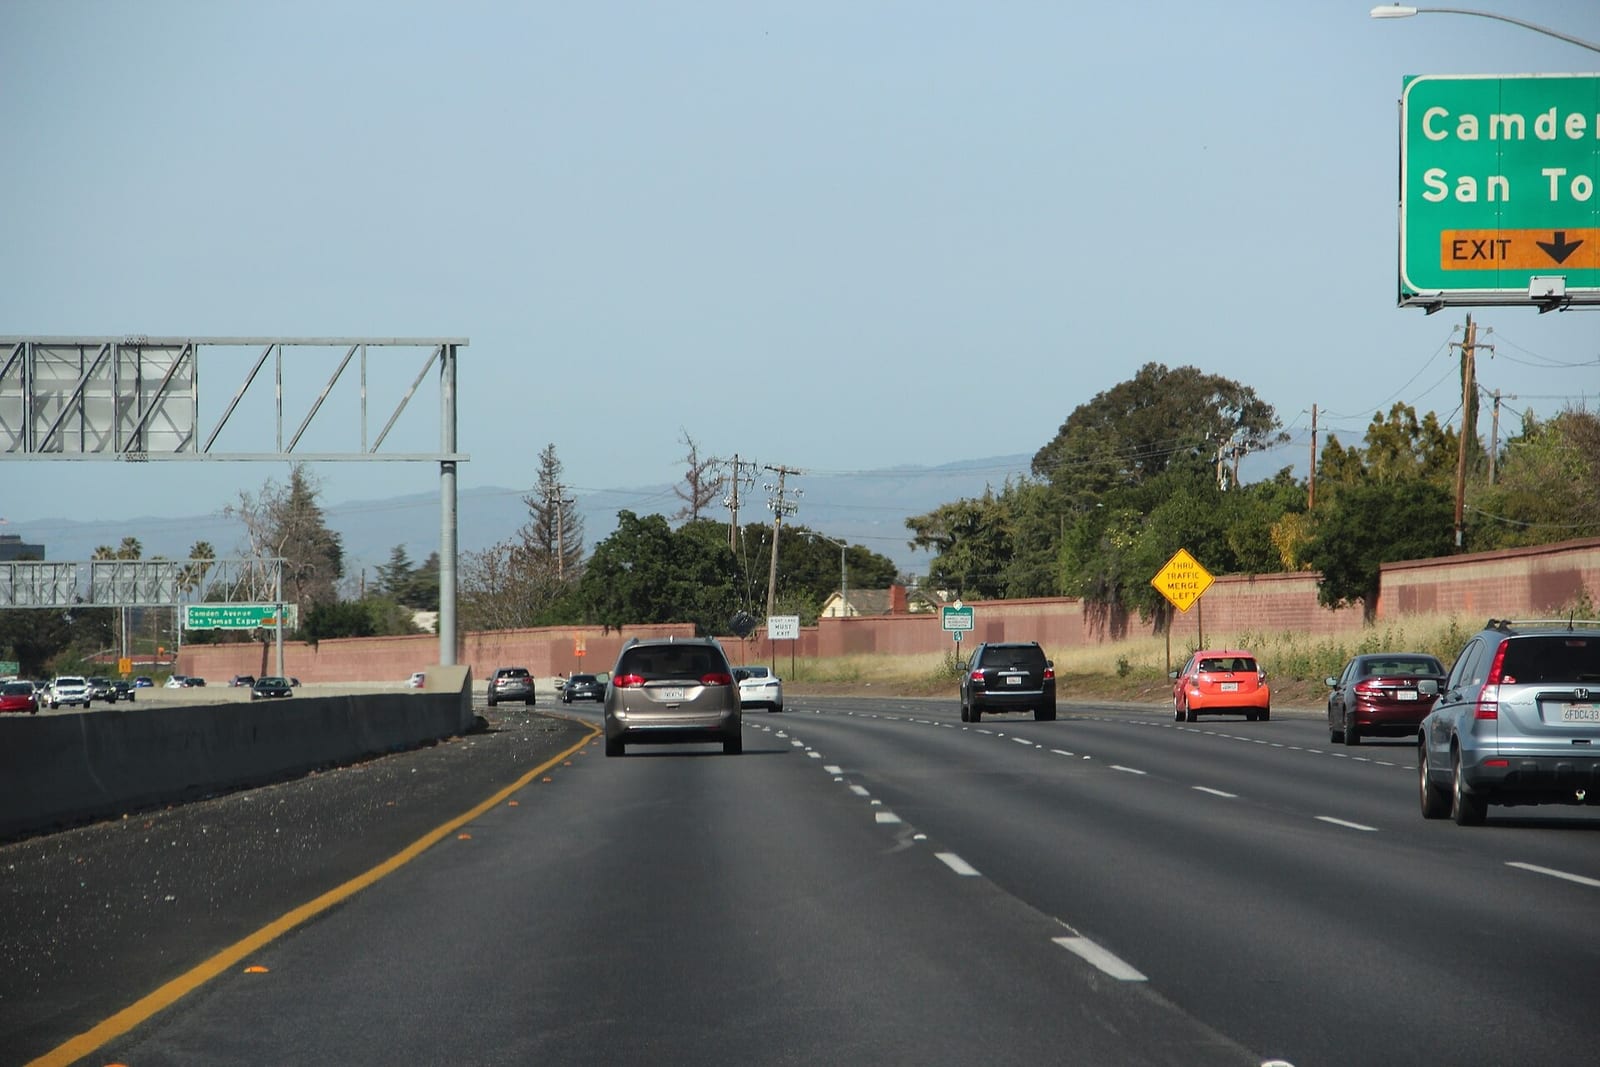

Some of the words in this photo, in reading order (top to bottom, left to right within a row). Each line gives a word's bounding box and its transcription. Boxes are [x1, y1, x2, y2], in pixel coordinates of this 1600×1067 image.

[1422, 106, 1600, 141] Camde
[1422, 168, 1509, 202] San
[1452, 239, 1512, 260] EXIT
[1167, 572, 1199, 580] TRAFFIC
[1564, 709, 1599, 720] 6FDC433
